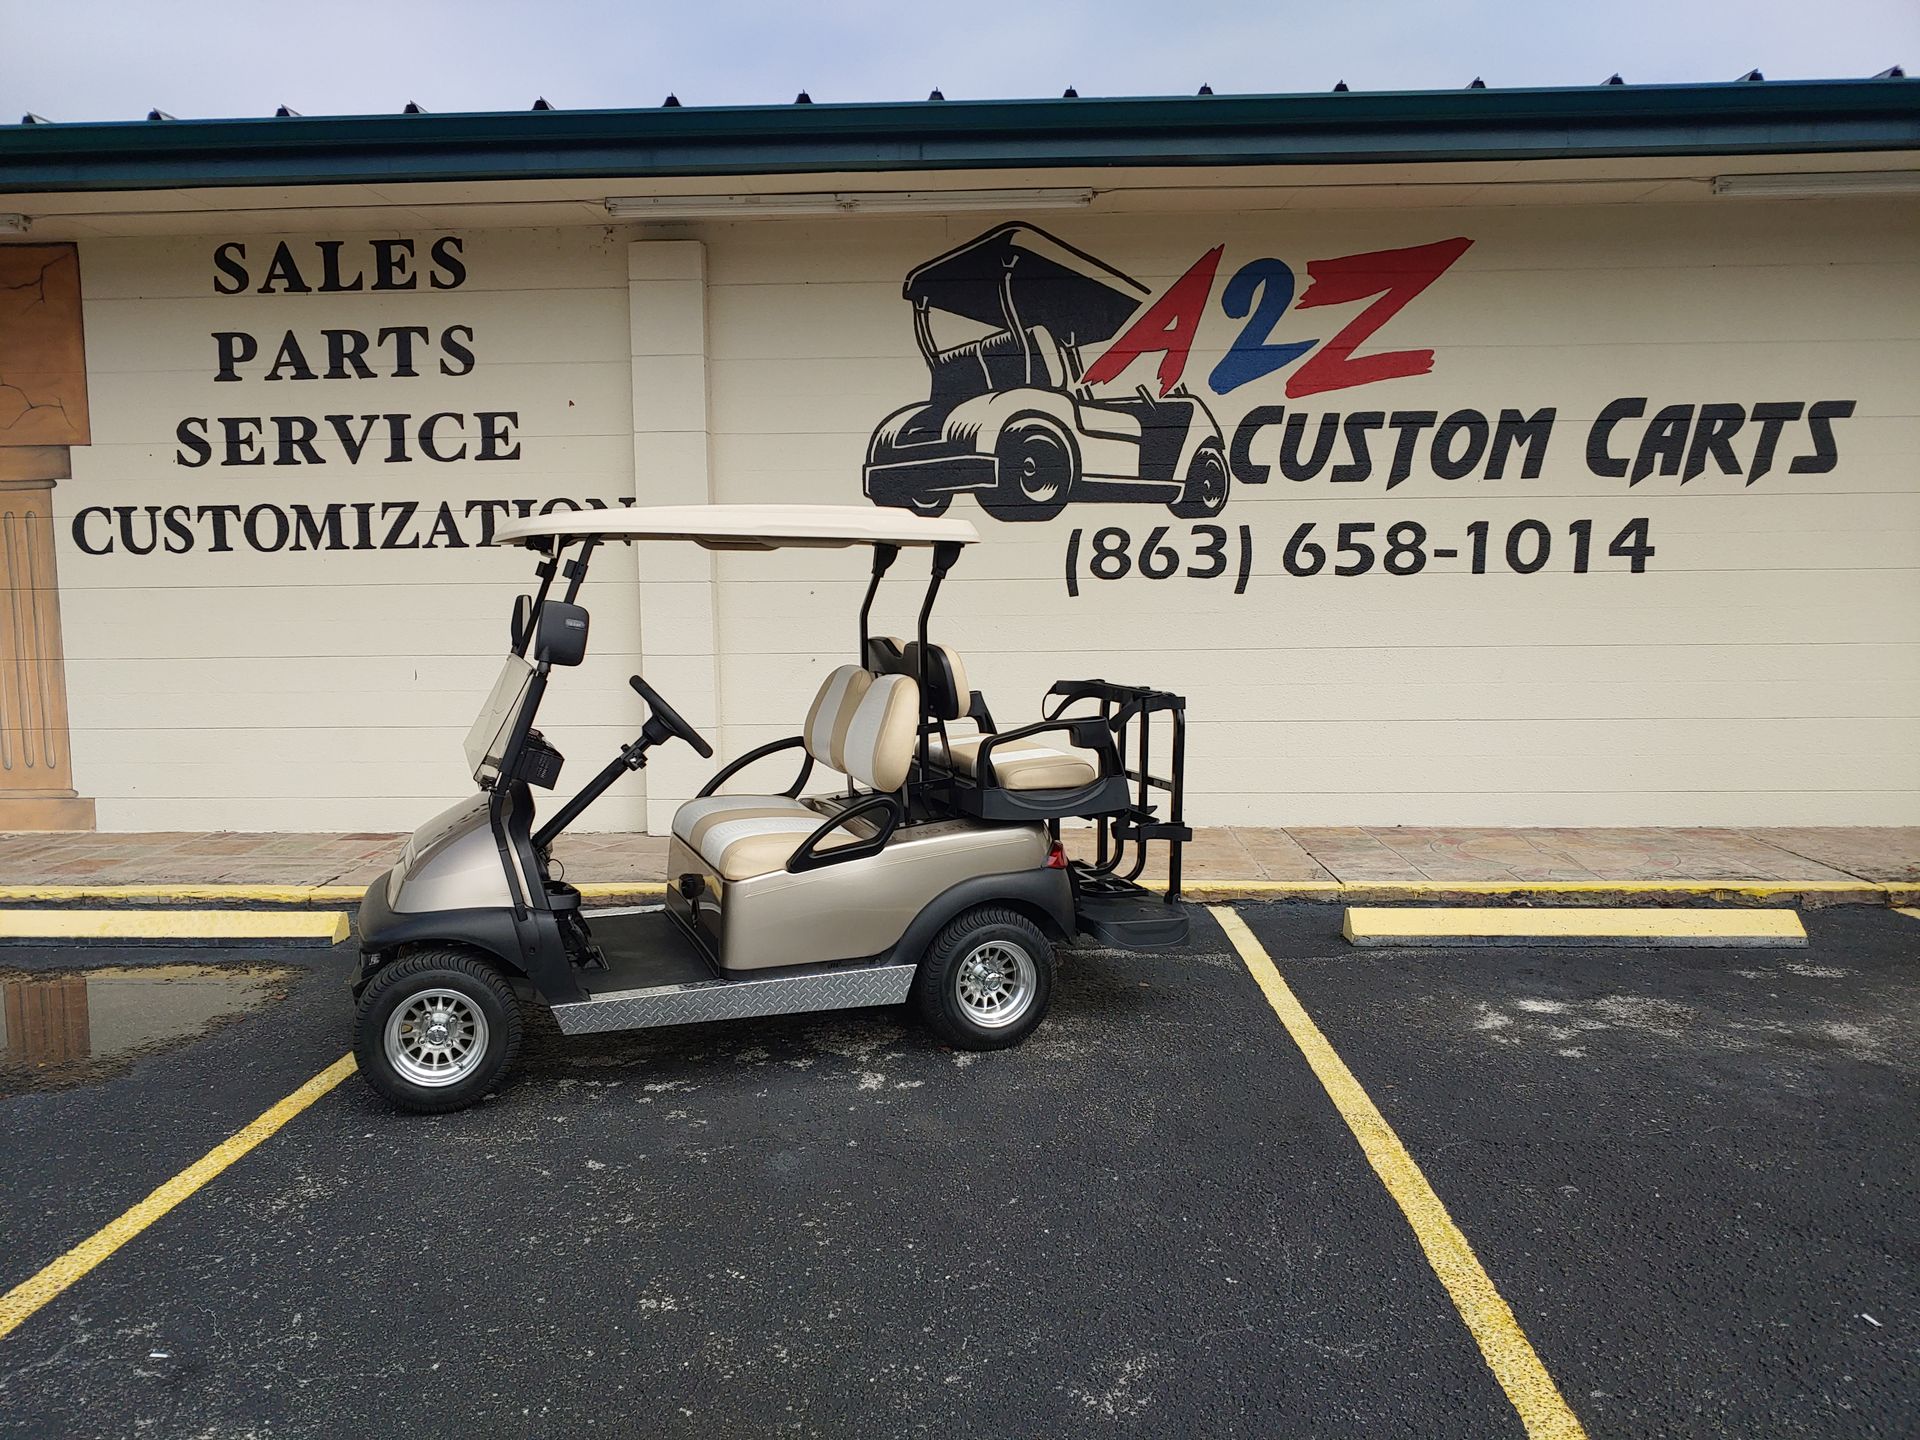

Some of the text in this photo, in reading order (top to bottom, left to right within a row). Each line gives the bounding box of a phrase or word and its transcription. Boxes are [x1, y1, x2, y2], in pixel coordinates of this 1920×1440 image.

[212, 236, 468, 295] SALES
[1081, 237, 1476, 399] A2Z
[211, 324, 476, 383] PARTS
[175, 411, 522, 468] SERVICE
[1230, 397, 1857, 492] CUSTOM CARTS
[71, 497, 637, 556] CUSTOMIZAT
[1065, 517, 1657, 598] (863) 658-1014
